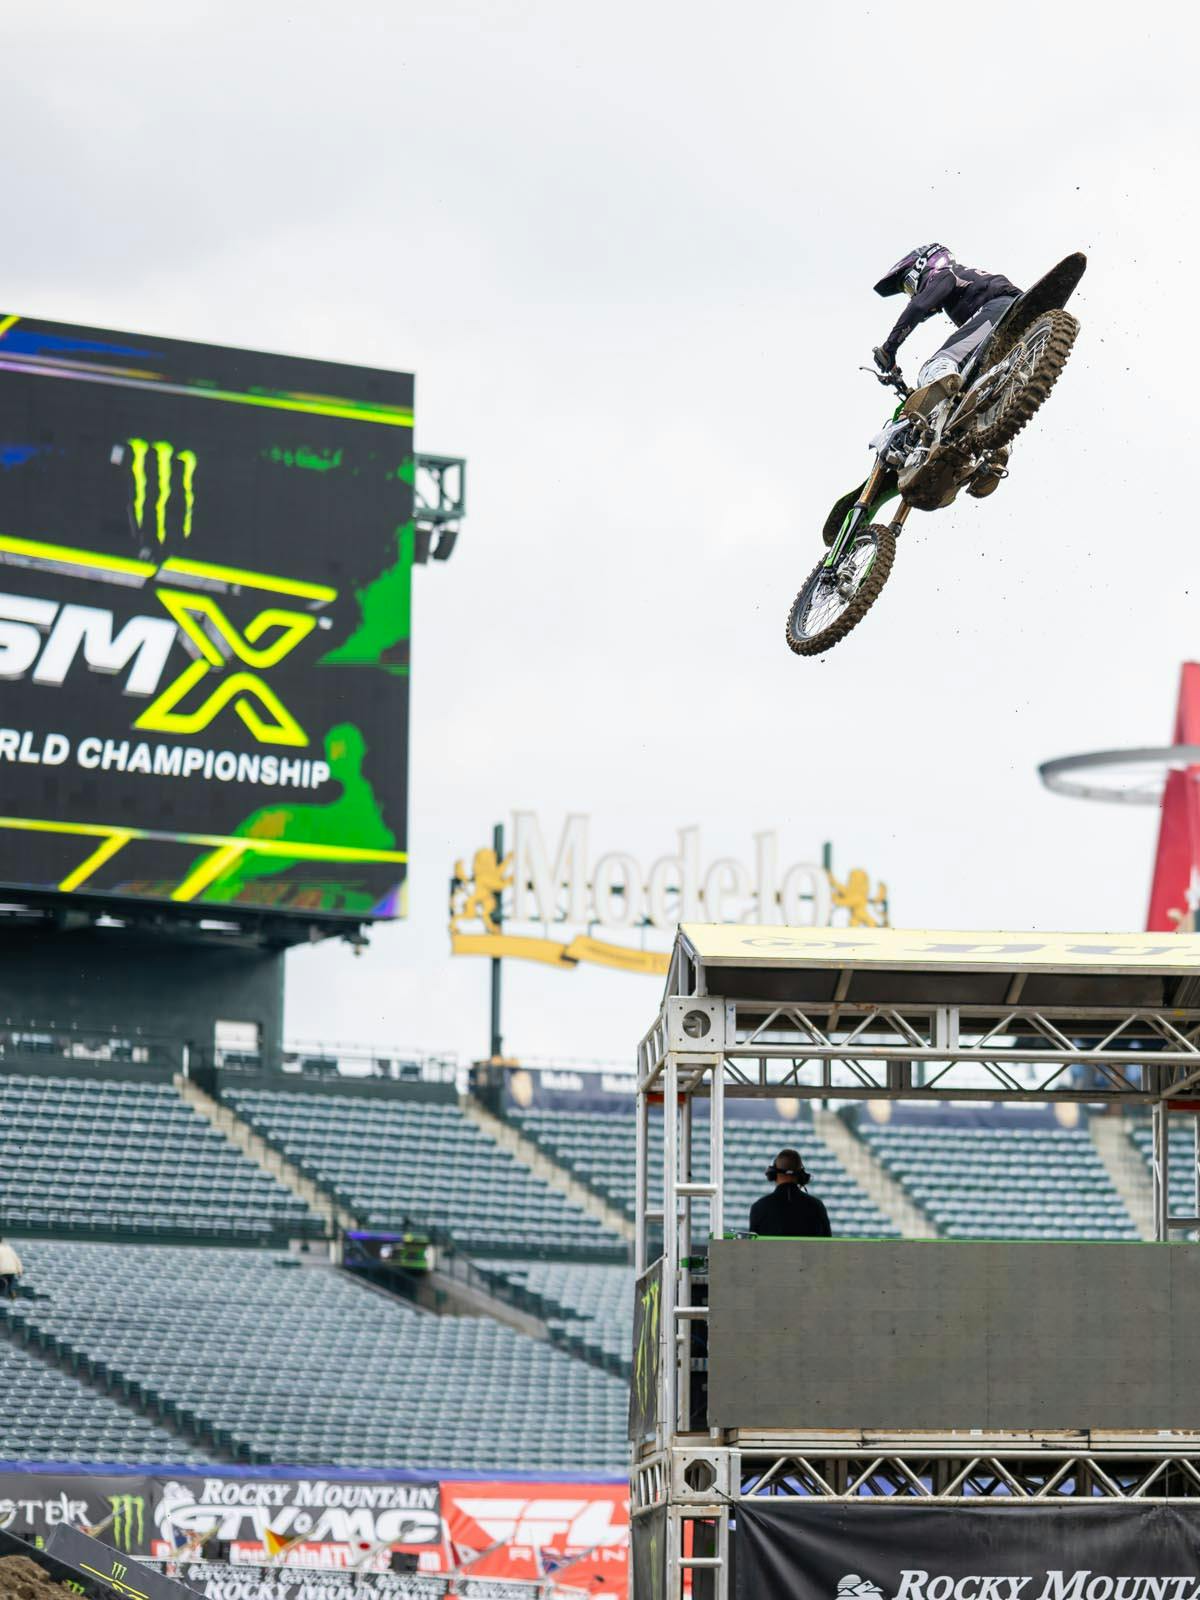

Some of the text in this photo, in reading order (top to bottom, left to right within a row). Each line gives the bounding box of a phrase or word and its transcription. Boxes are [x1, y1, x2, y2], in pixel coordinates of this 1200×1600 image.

[76, 736, 331, 789] CHAMPIONSHIP
[511, 809, 832, 930] Modelo
[199, 1478, 438, 1509] ROCKY MOUNTAIN
[893, 1569, 1033, 1600] ROCKY
